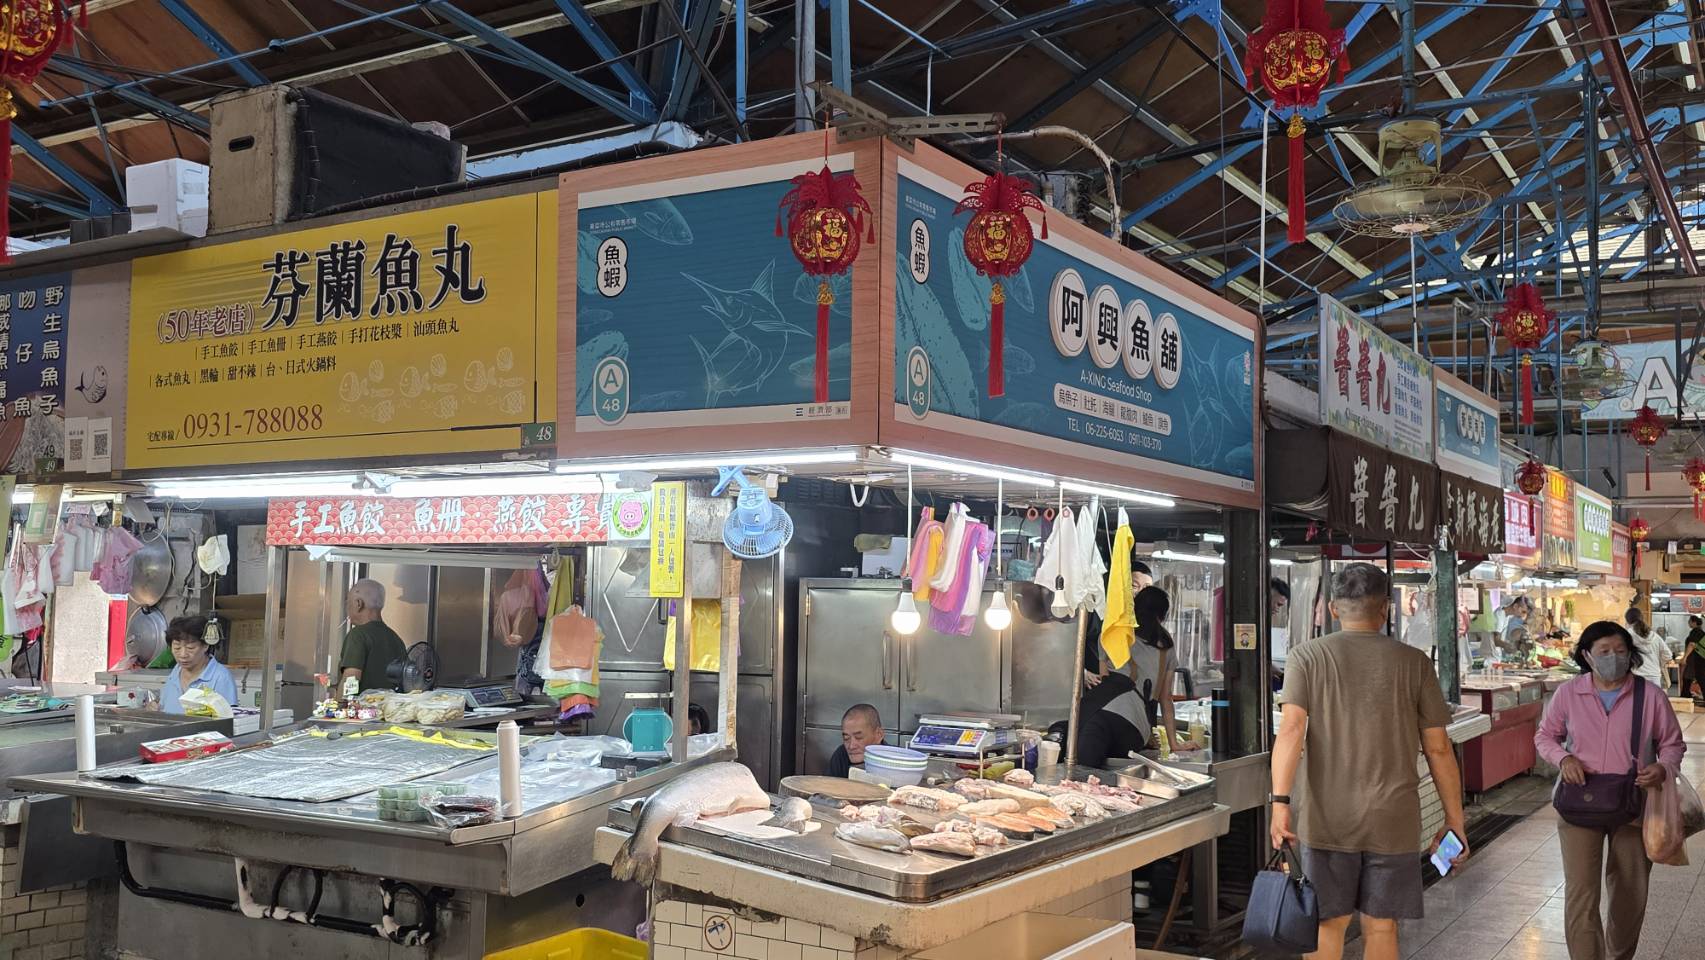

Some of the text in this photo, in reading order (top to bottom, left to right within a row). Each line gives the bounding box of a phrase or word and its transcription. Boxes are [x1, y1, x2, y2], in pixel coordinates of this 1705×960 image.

[603, 244, 621, 289] 魚蝦
[914, 226, 926, 275] 魚蝦
[260, 223, 488, 331] 芬蘭魚丸
[13, 291, 37, 417] 吻仔魚
[39, 285, 64, 415] 野生烏魚子
[201, 342, 239, 360] 手工魚餃
[296, 329, 337, 350] 手工燕餃
[413, 317, 460, 337] 汕頭魚丸
[155, 370, 191, 388] 各式魚丸
[199, 368, 219, 384] 黑輪
[227, 363, 257, 382] 甜不辣
[603, 367, 619, 389] A
[913, 359, 924, 380] A
[1080, 369, 1152, 404] A-XING Seafood Shop
[602, 398, 620, 412] 48
[912, 390, 925, 406] 48
[183, 403, 323, 439] 0931-788088
[535, 425, 553, 441] 48
[1067, 417, 1081, 432] TEL
[43, 444, 56, 458] 49
[290, 501, 385, 537] 手工魚餃
[492, 496, 548, 533] 燕餃
